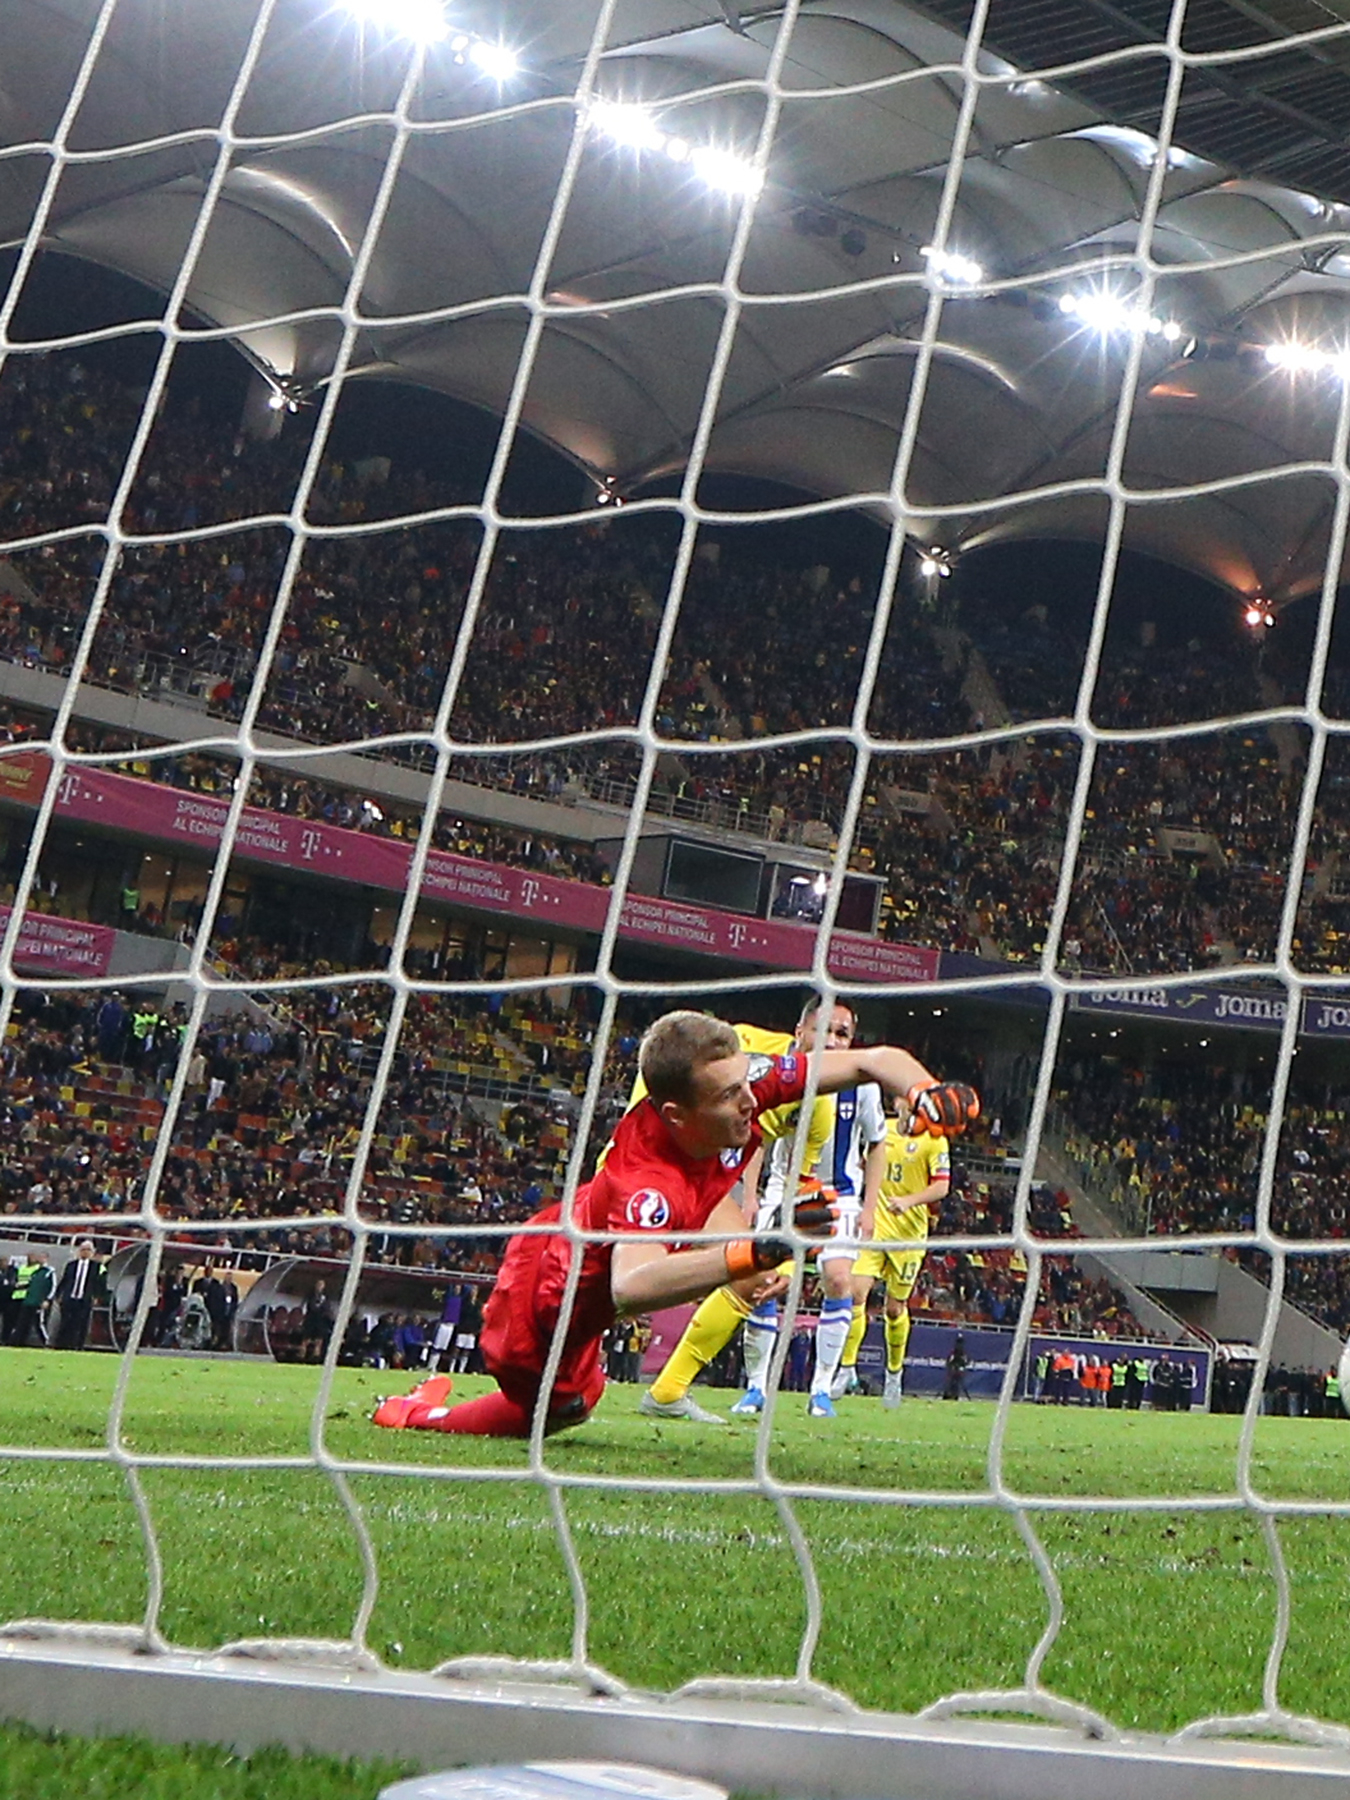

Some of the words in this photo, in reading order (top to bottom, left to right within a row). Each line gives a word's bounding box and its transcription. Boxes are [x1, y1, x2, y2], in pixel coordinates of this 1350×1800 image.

[172, 817, 187, 831] AL
[886, 1162, 903, 1183] 13
[901, 1261, 917, 1281] 13
